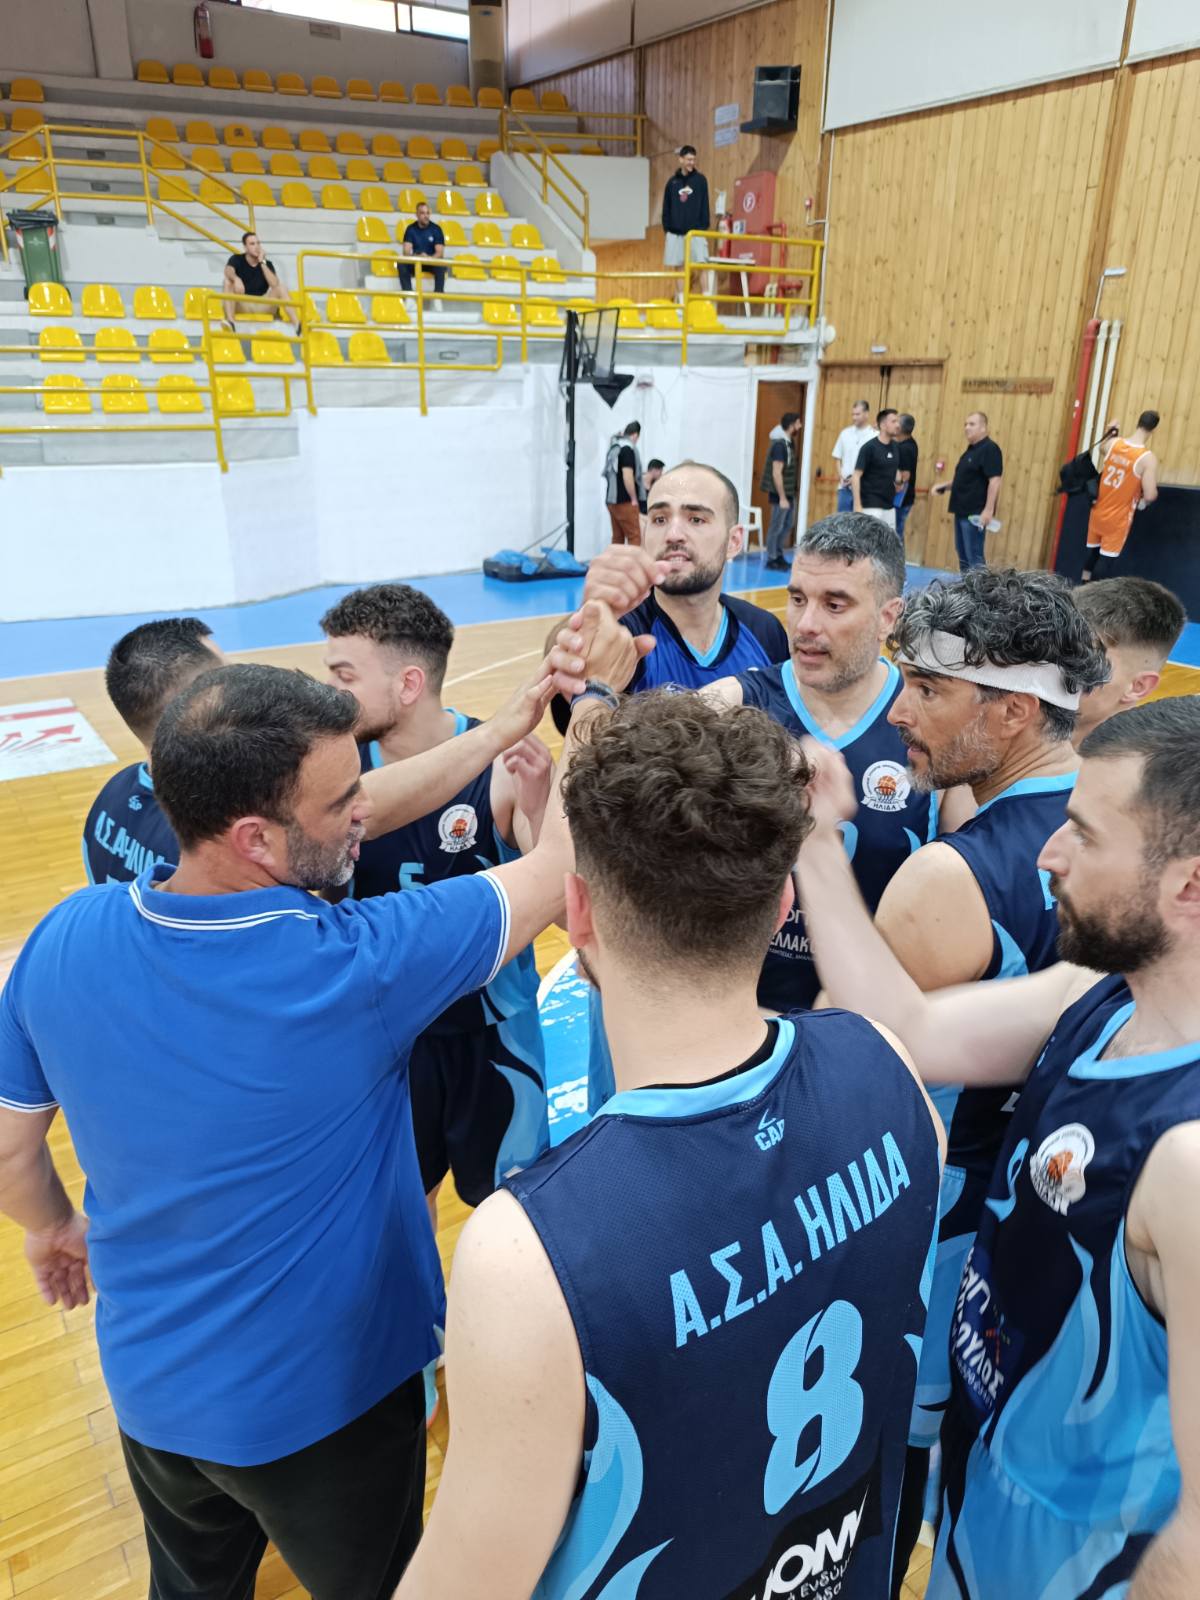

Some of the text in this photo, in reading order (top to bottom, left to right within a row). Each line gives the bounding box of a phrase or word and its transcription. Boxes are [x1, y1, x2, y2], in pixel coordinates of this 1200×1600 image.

[1103, 465, 1125, 489] 23
[669, 1219, 803, 1349] Α.Σ.Α.
[793, 1131, 911, 1261] ΗΛΙΔΑ
[764, 1299, 863, 1516] 8
